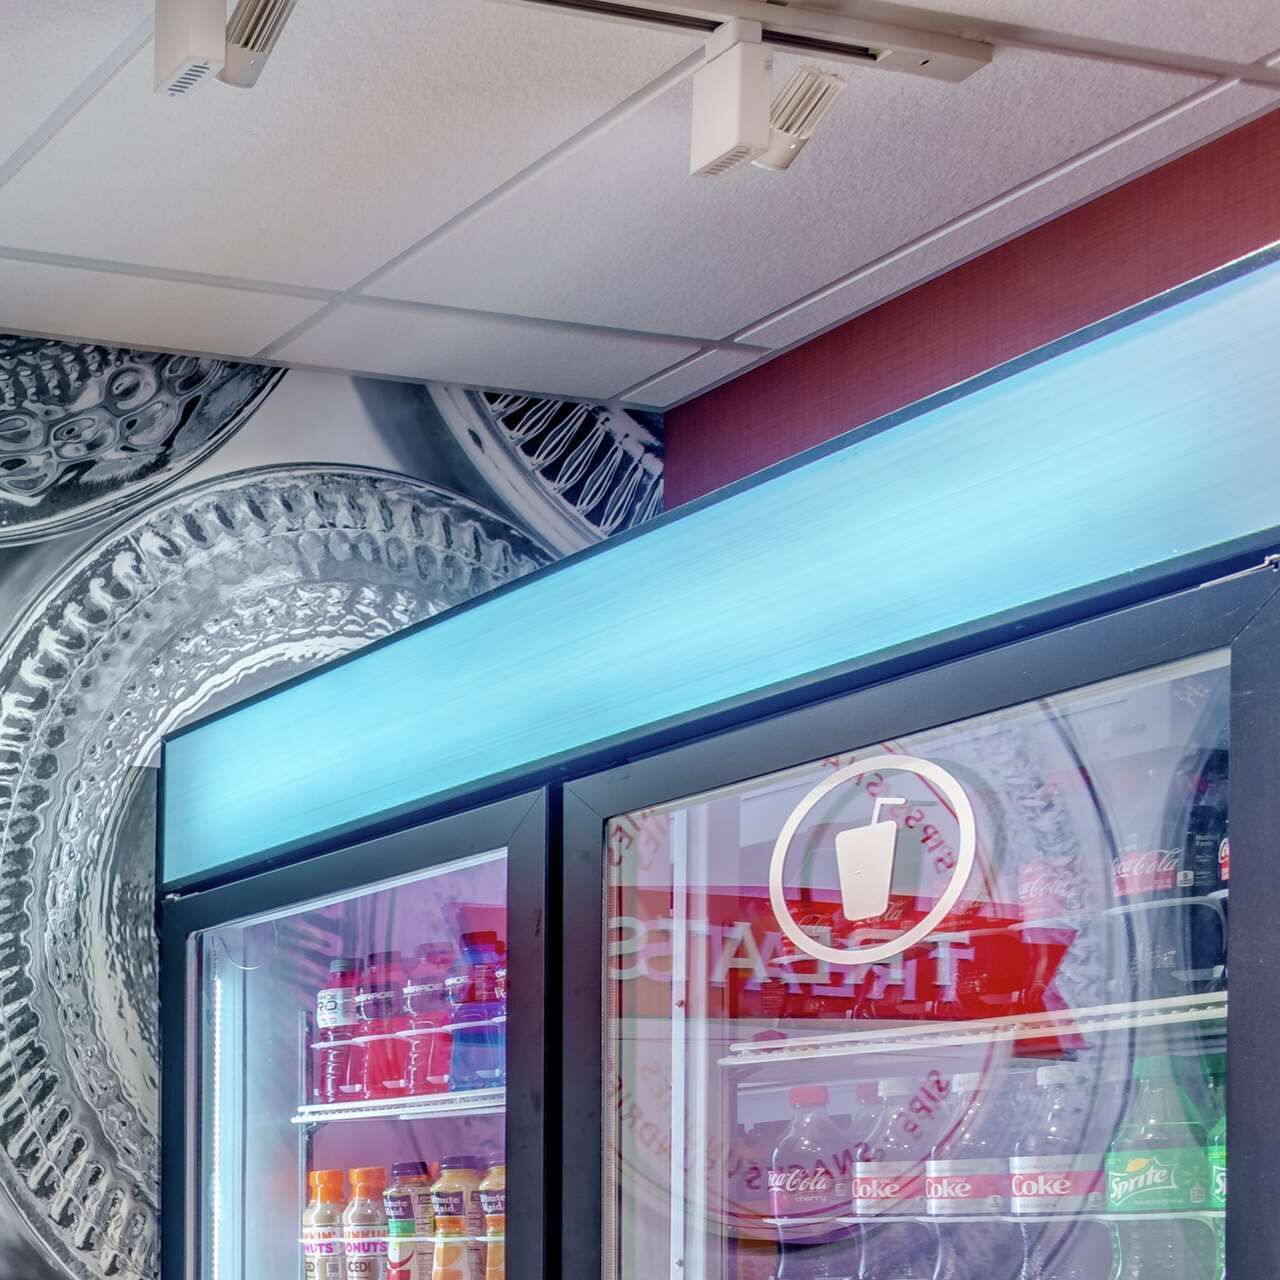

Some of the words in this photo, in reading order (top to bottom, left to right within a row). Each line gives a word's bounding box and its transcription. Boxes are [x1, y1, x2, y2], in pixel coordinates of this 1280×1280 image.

[852, 1176, 900, 1199] Coke
[926, 1176, 971, 1198] Coke
[1011, 1174, 1072, 1197] Coke
[1110, 1163, 1169, 1200] Sprite
